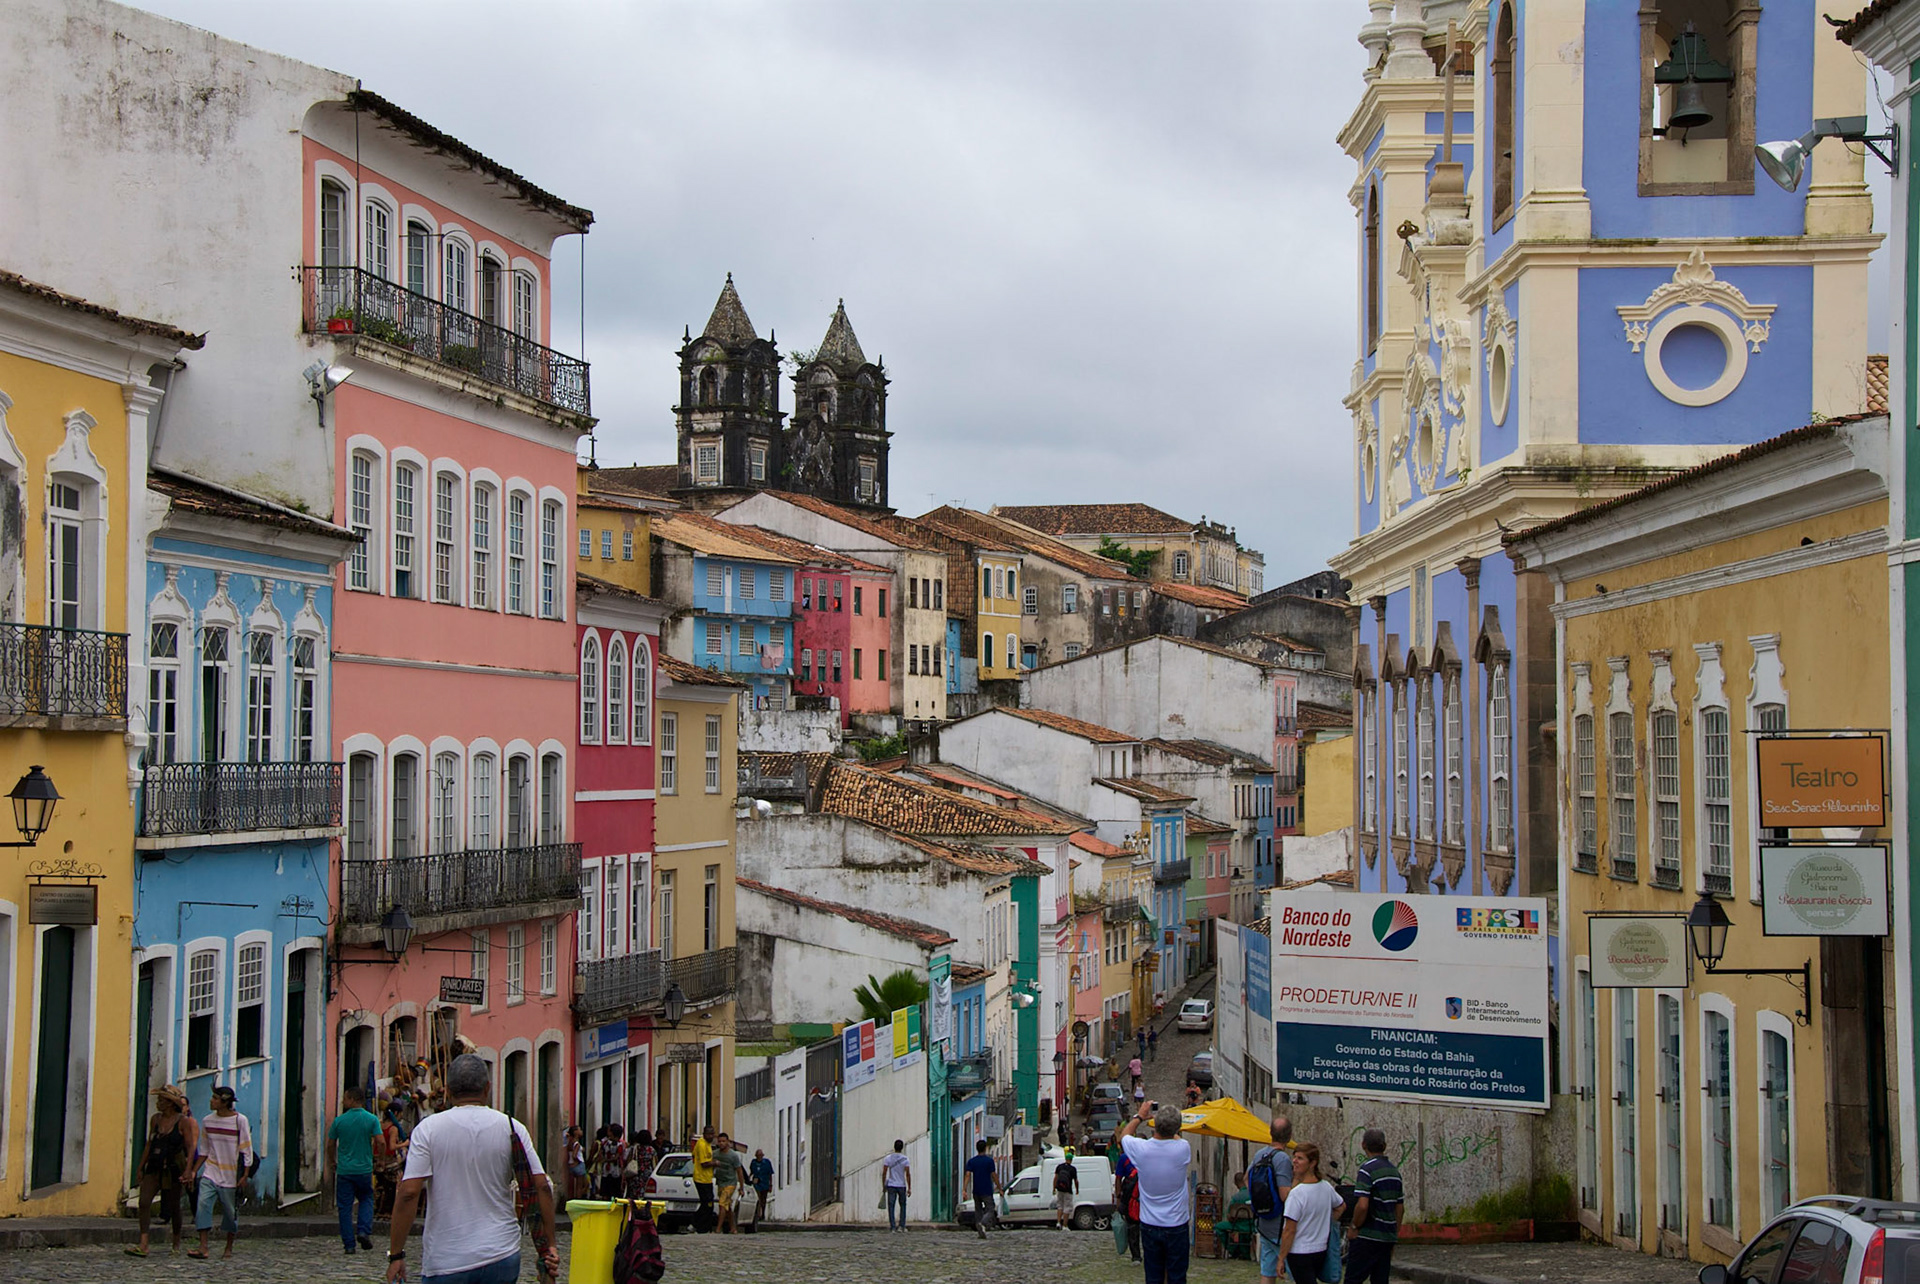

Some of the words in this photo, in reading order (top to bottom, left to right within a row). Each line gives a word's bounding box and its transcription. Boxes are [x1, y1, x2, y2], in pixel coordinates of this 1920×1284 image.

[1781, 762, 1858, 788] Teatro
[1765, 800, 1791, 813] Sesc
[1791, 800, 1821, 813] Senac
[1822, 799, 1880, 813] Pelourinho
[1804, 862, 1833, 871] Museu
[1833, 863, 1843, 871] da
[1801, 872, 1848, 885] Gastronomia
[1778, 893, 1836, 905] Restaurante
[1838, 893, 1873, 906] Escola
[1282, 907, 1329, 926] Banco
[1332, 908, 1351, 927] do
[1457, 908, 1538, 928] BRASIL
[1806, 908, 1835, 917] senac
[1282, 927, 1351, 947] Nordeste
[1280, 987, 1403, 1008] PRODETUR/NE
[1408, 993, 1418, 1009] II
[1485, 1000, 1508, 1008] Banco
[1312, 1007, 1354, 1016] Desenvolvimento
[1391, 1011, 1414, 1019] Nordeste
[1467, 1007, 1519, 1016] Interamericano
[1479, 1014, 1541, 1024] Desenvolvimento
[1371, 1029, 1438, 1045] FINANCIAM:
[1335, 1043, 1377, 1056] Governo
[1379, 1046, 1391, 1056] do
[1394, 1047, 1429, 1059] Estado
[1431, 1050, 1443, 1060] da
[1446, 1051, 1475, 1063] Bahia
[1313, 1056, 1360, 1070] Execução
[1362, 1060, 1380, 1071] das
[1382, 1062, 1410, 1073] obras
[1413, 1064, 1425, 1074] de
[1428, 1066, 1487, 1079] restauração
[1490, 1069, 1503, 1079] da
[1294, 1067, 1320, 1080] Igreja
[1322, 1070, 1334, 1079] de
[1336, 1071, 1367, 1082] Nossa
[1369, 1073, 1410, 1085] Senhora
[1412, 1077, 1426, 1087] do
[1428, 1078, 1467, 1090] Rosário
[1470, 1080, 1488, 1091] dos
[1491, 1081, 1526, 1093] Pretos
